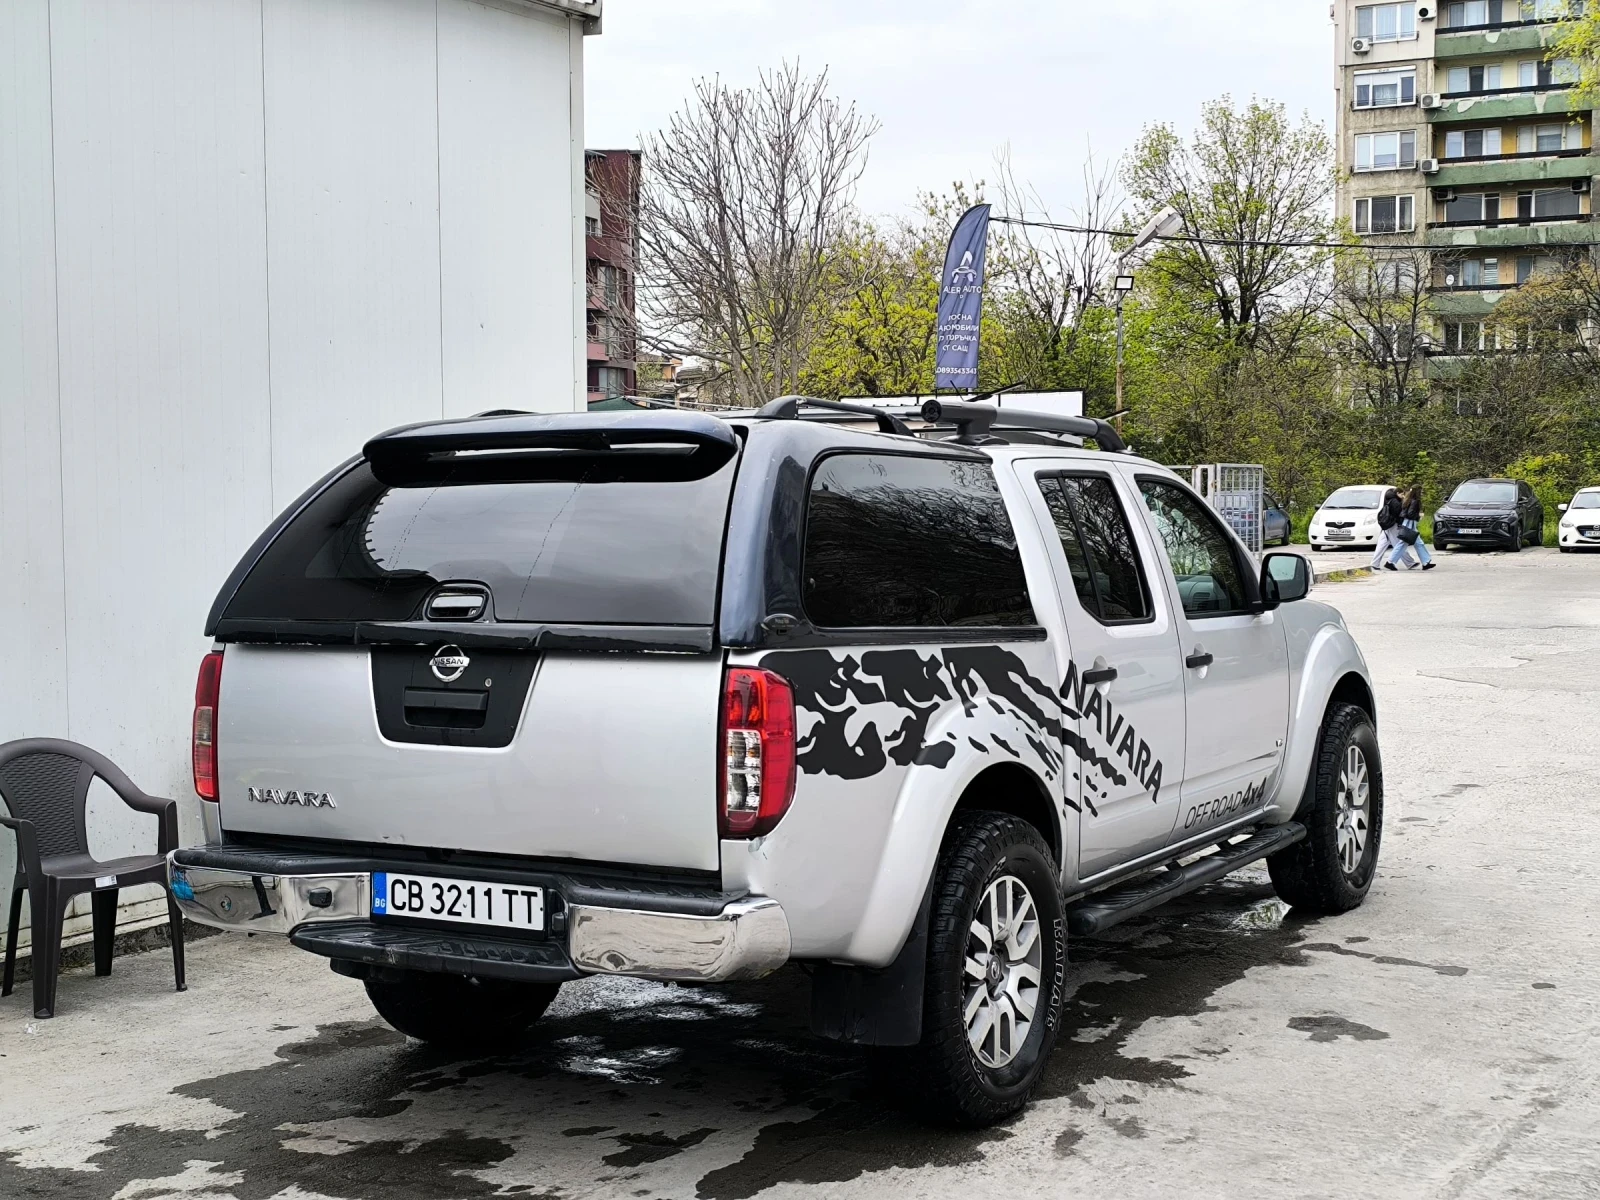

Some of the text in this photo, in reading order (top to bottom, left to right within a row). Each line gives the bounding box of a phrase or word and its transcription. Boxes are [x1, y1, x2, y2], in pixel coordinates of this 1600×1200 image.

[432, 657, 464, 665] NISSAN
[1060, 659, 1164, 804] NAVARA
[248, 786, 337, 808] NAVARA
[374, 898, 386, 908] BG
[430, 882, 493, 920] 3211
[502, 888, 538, 924] TT
